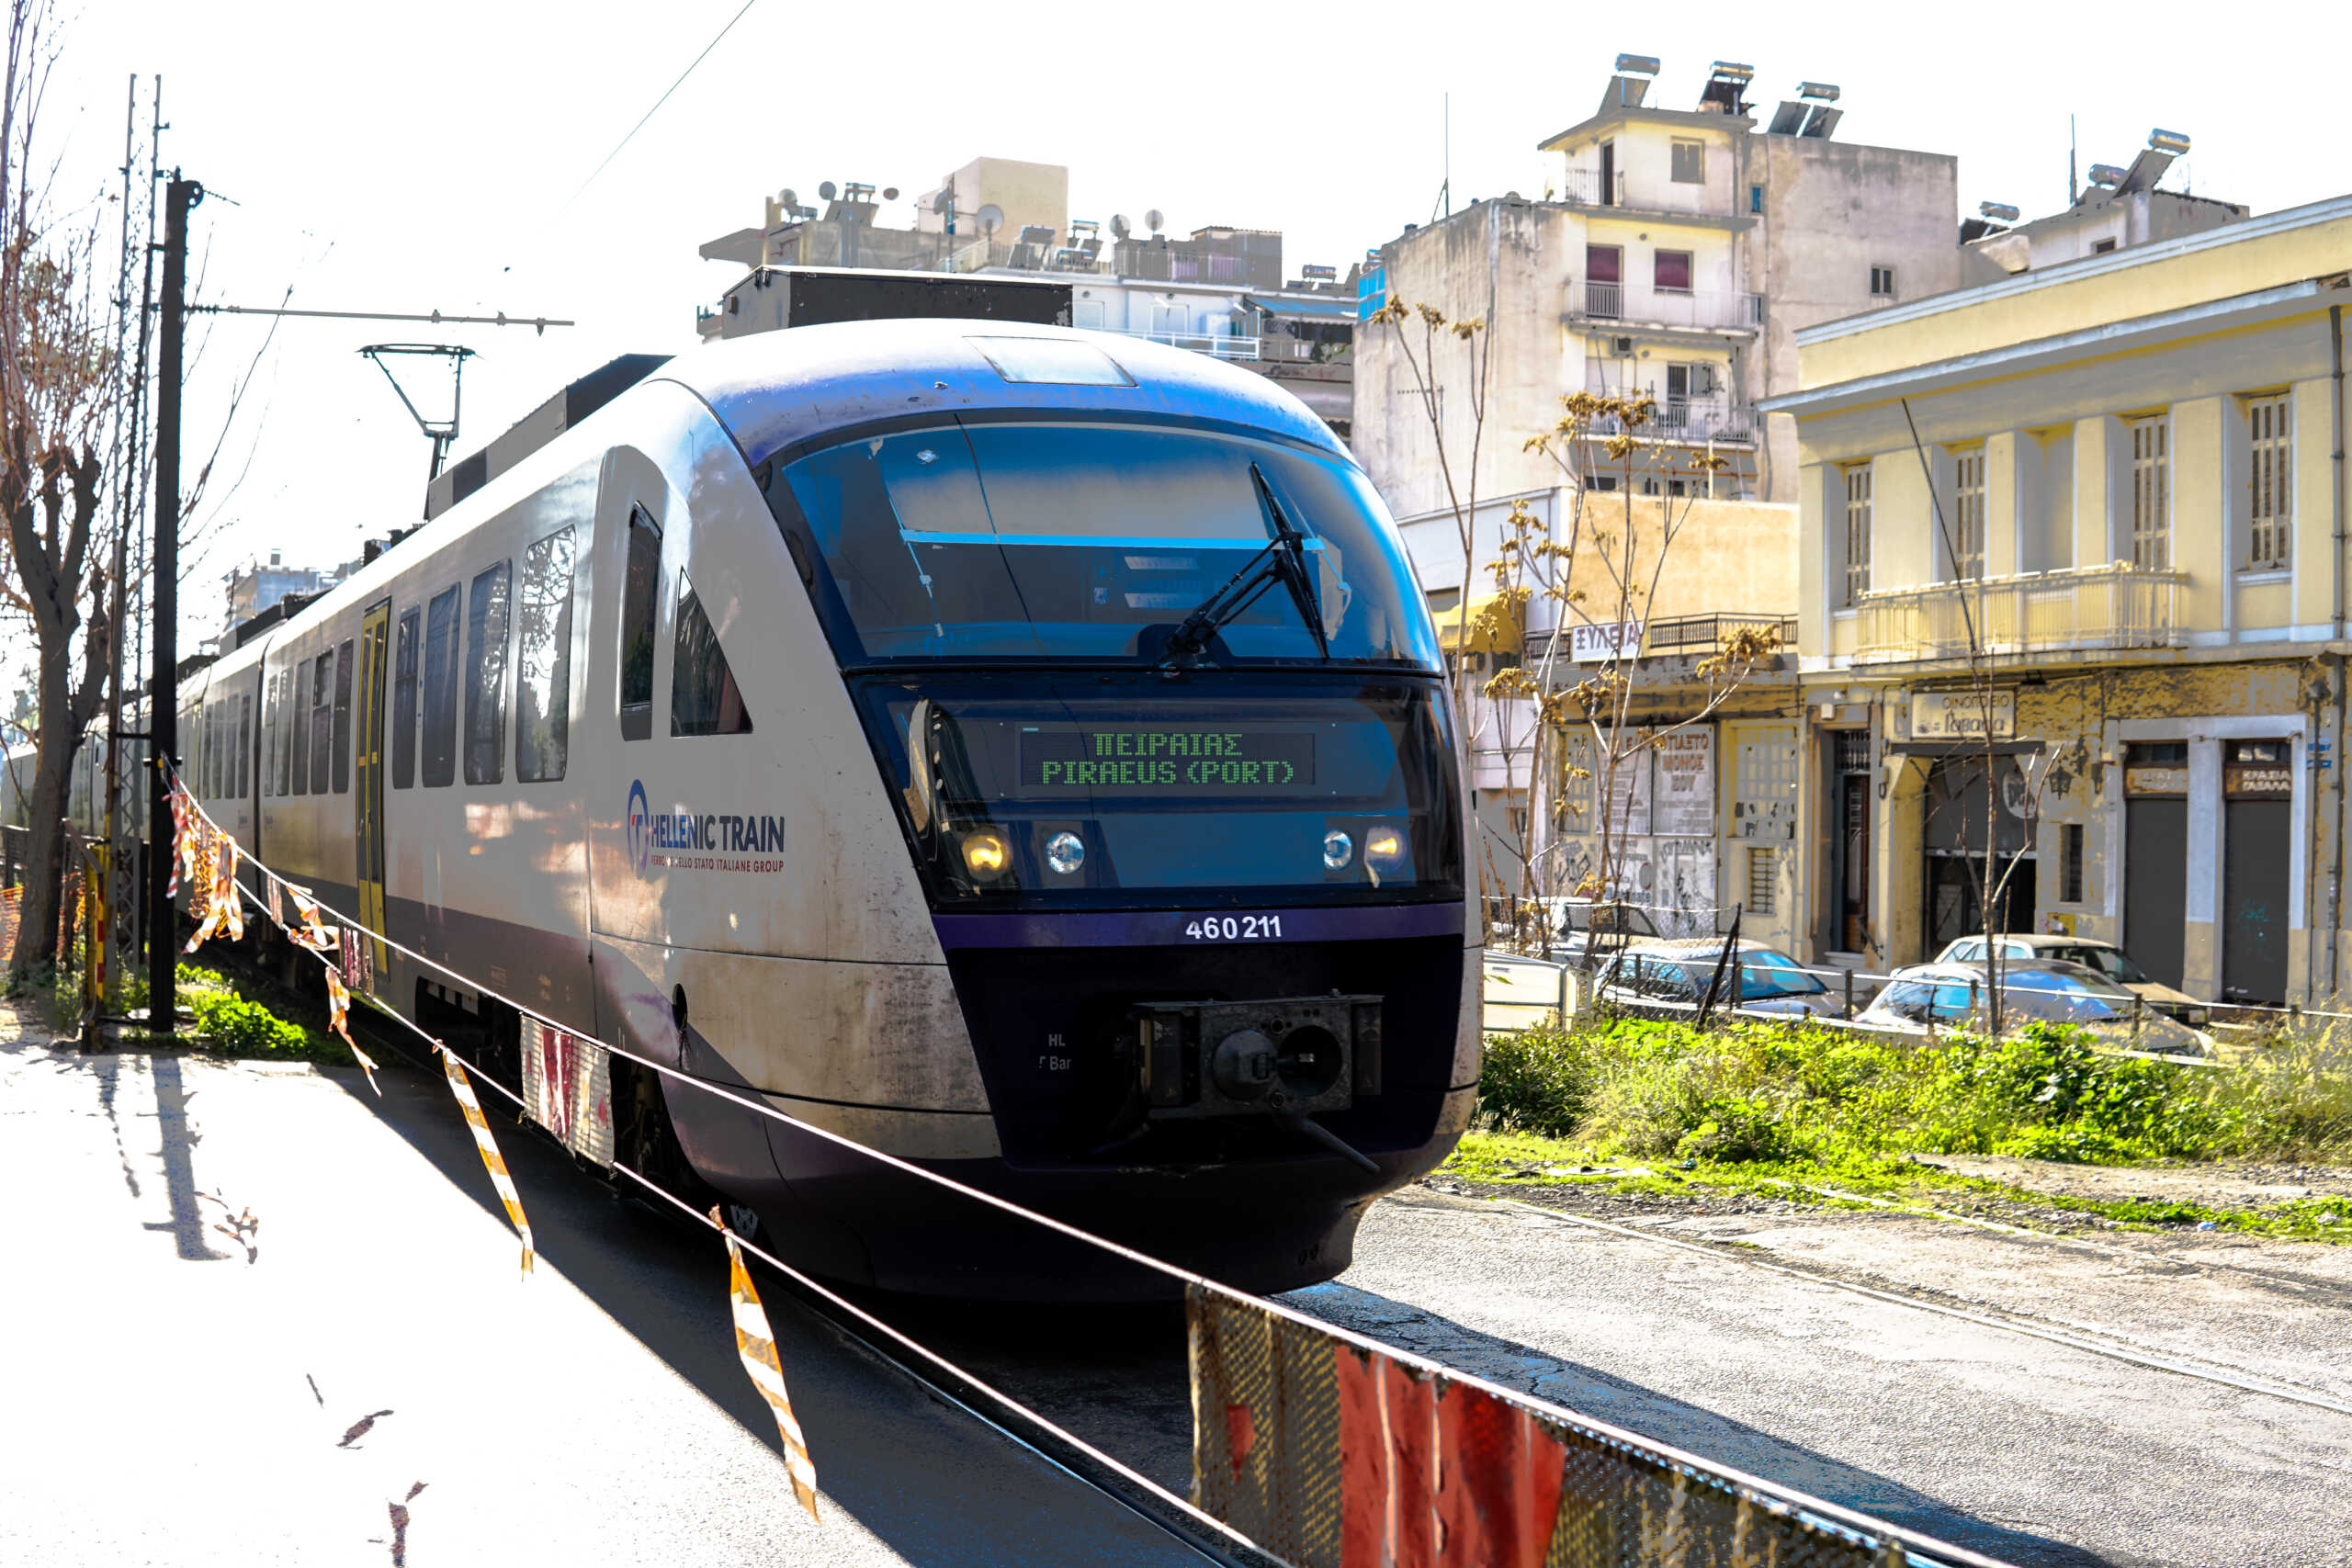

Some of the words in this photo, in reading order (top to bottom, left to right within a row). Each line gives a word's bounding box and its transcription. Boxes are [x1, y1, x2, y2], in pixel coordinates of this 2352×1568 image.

[1093, 733, 1243, 756] ΠΕΙΡΑΙΑΣ
[1043, 761, 1177, 784] PIRAEUS
[1186, 761, 1295, 784] (PORT)
[650, 814, 716, 851] HELLENIC
[718, 815, 786, 852] TRAIN
[694, 858, 715, 870] STATO
[717, 859, 751, 872] ITALIANE
[753, 860, 784, 874] GROUP
[1048, 1033, 1066, 1047] HL
